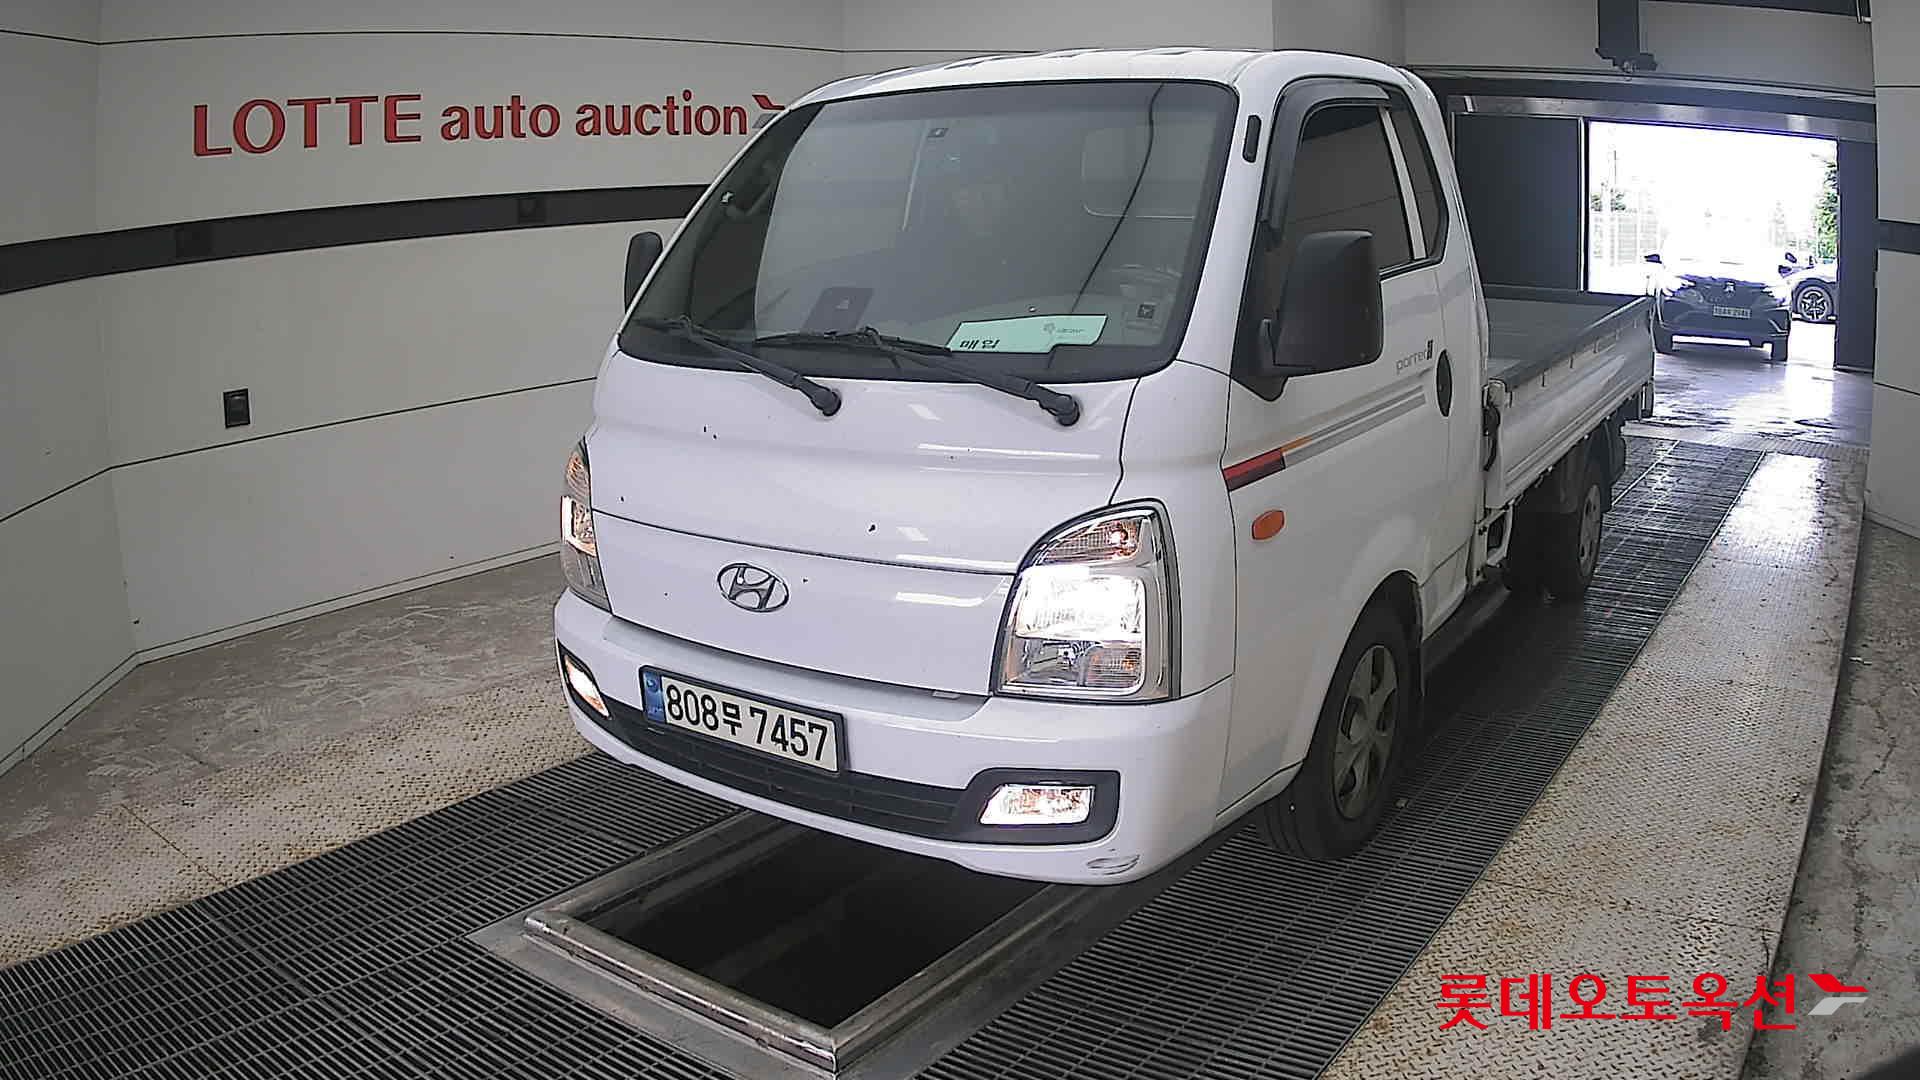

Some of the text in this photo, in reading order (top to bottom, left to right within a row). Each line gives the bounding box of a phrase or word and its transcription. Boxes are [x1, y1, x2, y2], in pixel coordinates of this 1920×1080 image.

[193, 89, 749, 157] LOTTE auto auction
[666, 684, 828, 761] 808무 7457
